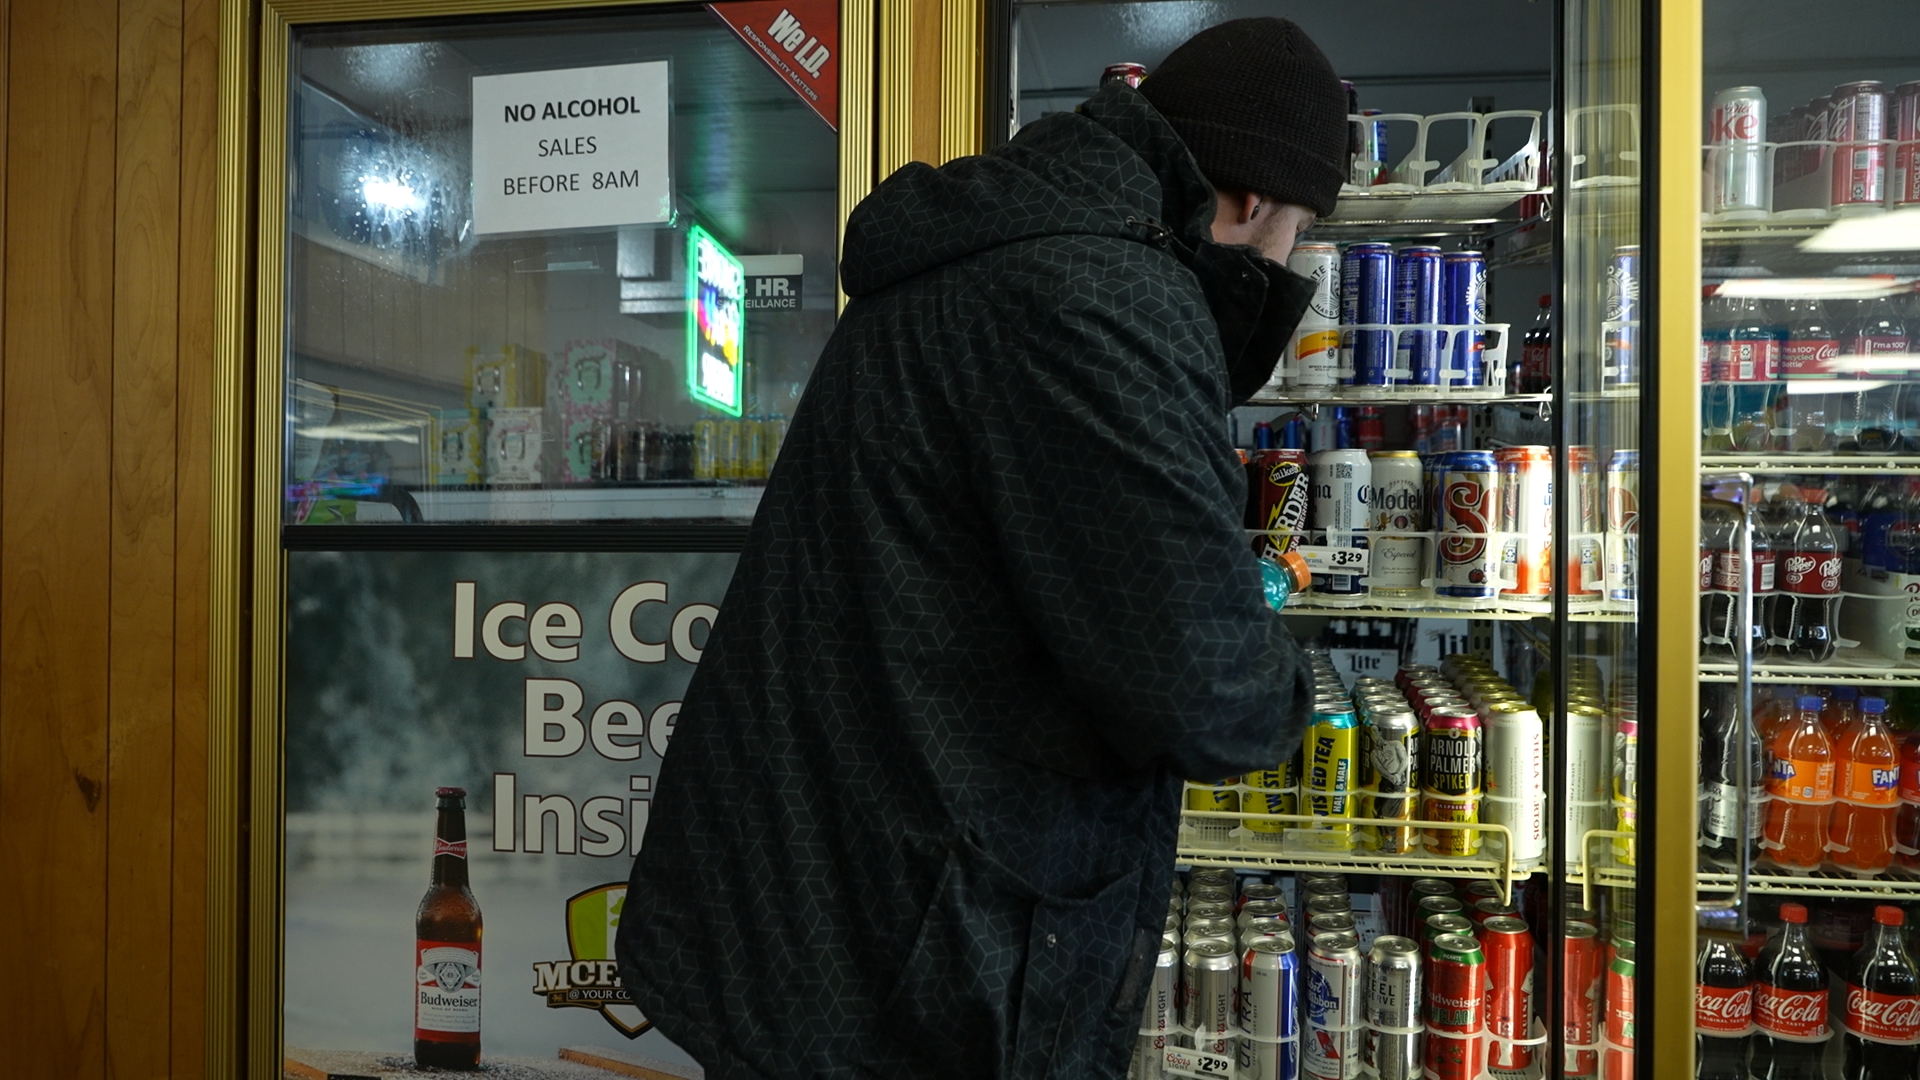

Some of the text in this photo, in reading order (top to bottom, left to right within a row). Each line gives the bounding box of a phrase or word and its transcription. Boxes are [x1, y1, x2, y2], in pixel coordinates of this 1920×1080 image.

[767, 8, 830, 79] We I.D.
[743, 25, 818, 101] RESPONSIBILITY MATTERS
[504, 96, 641, 123] NO ALCOHOL
[1724, 102, 1752, 114] Diet
[1710, 108, 1758, 142] ke
[538, 137, 597, 157] SALES
[503, 170, 640, 196] BEFORE 8AM
[756, 278, 796, 297] HR.
[717, 298, 796, 309] SEILLANCE
[1371, 487, 1422, 510] Model
[1787, 556, 1814, 572] Dr Pepper
[453, 581, 724, 664] Ice Co
[1437, 634, 1468, 661] Lit
[1350, 654, 1380, 673] Lite
[524, 677, 685, 761] Bee
[1314, 736, 1335, 765] TEA
[1430, 738, 1476, 757] ARNOLD
[1338, 760, 1347, 783] HALF
[1430, 756, 1476, 774] PALMER
[1773, 760, 1795, 775] NTA
[1433, 773, 1471, 790] SPIKED
[1873, 766, 1900, 784] FANT
[1264, 770, 1284, 814] TWIST
[493, 772, 653, 858] Insi
[1442, 953, 1462, 961] PICANTE
[533, 961, 621, 992] MCF
[582, 990, 613, 999] YOUR
[1370, 979, 1395, 997] EEL
[421, 991, 477, 1007] Budweiser
[1308, 991, 1337, 1009] ibbon
[1368, 991, 1395, 1006] SERVE
[1427, 992, 1481, 1008] udweiser
[1695, 986, 1752, 1018] oca-Cola
[1753, 984, 1823, 1022] Coca-Cola
[1154, 990, 1166, 1050] Cors LIGHT
[1431, 1007, 1476, 1026] HELADA
[1699, 1015, 1728, 1023] ORIGINAL
[1214, 1023, 1225, 1053] Cors
[1166, 1053, 1191, 1067] Coors
